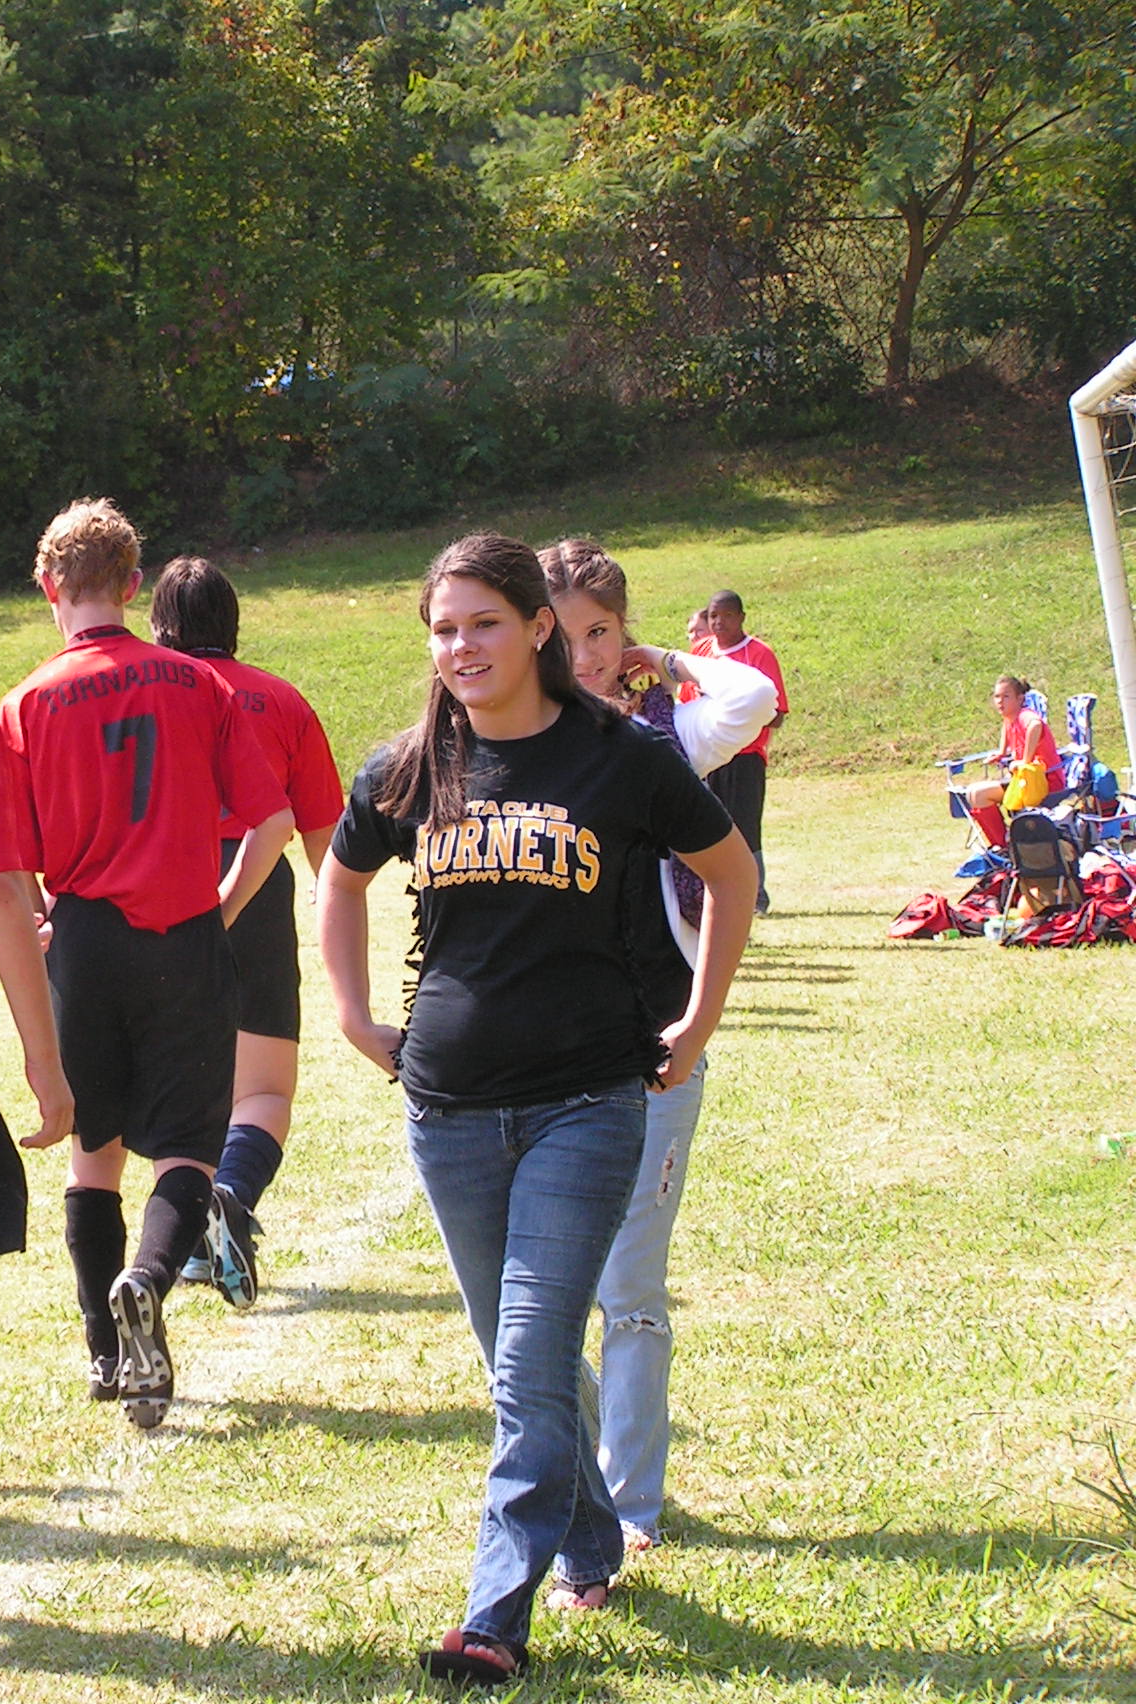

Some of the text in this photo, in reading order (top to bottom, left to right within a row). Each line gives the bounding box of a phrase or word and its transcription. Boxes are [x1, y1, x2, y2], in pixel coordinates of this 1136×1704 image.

[36, 659, 198, 716] TORNADOS
[102, 712, 158, 824] 7
[466, 799, 569, 823] TA CLUB
